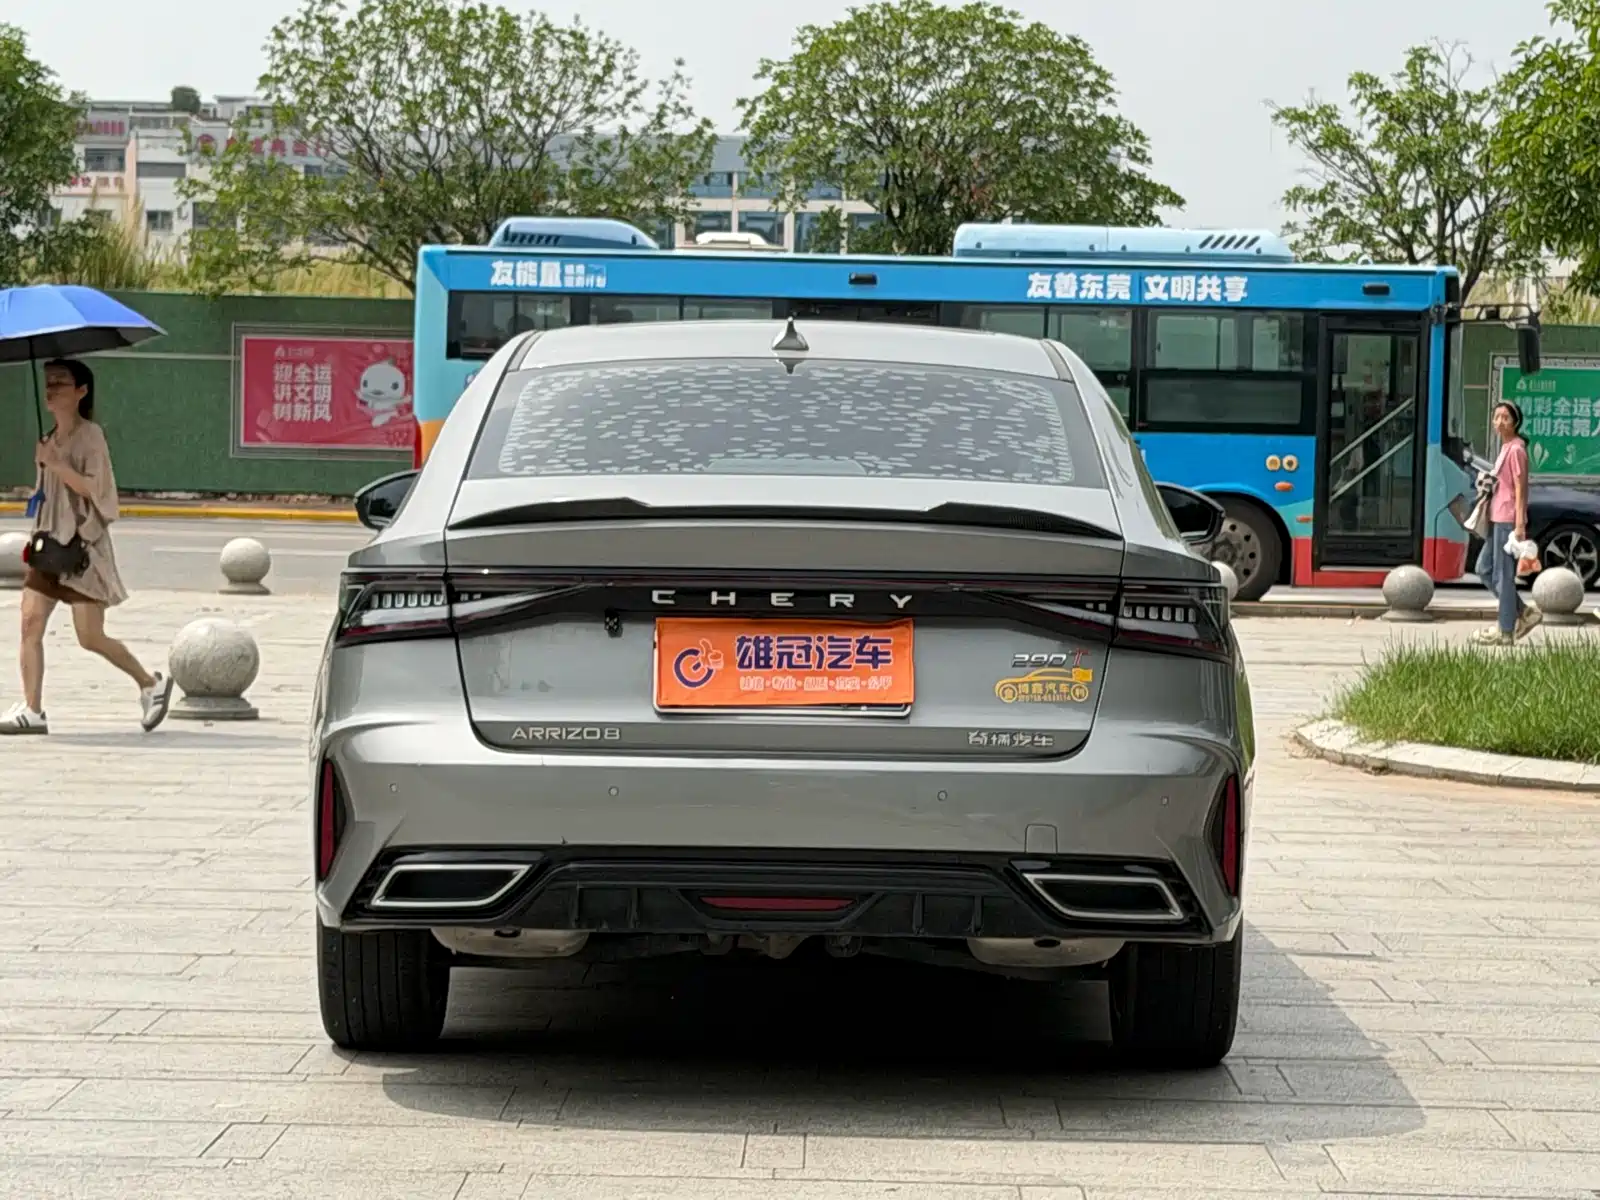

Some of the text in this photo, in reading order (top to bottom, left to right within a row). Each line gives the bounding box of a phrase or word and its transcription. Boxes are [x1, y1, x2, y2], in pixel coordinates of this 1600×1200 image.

[1027, 272, 1248, 301] 友善东莞 文明共享
[273, 363, 332, 383] 迎全运
[273, 384, 332, 402] 讲文明
[273, 403, 332, 422] 树新风
[651, 589, 913, 609] CHERY
[736, 635, 893, 670] 雄冠汽车
